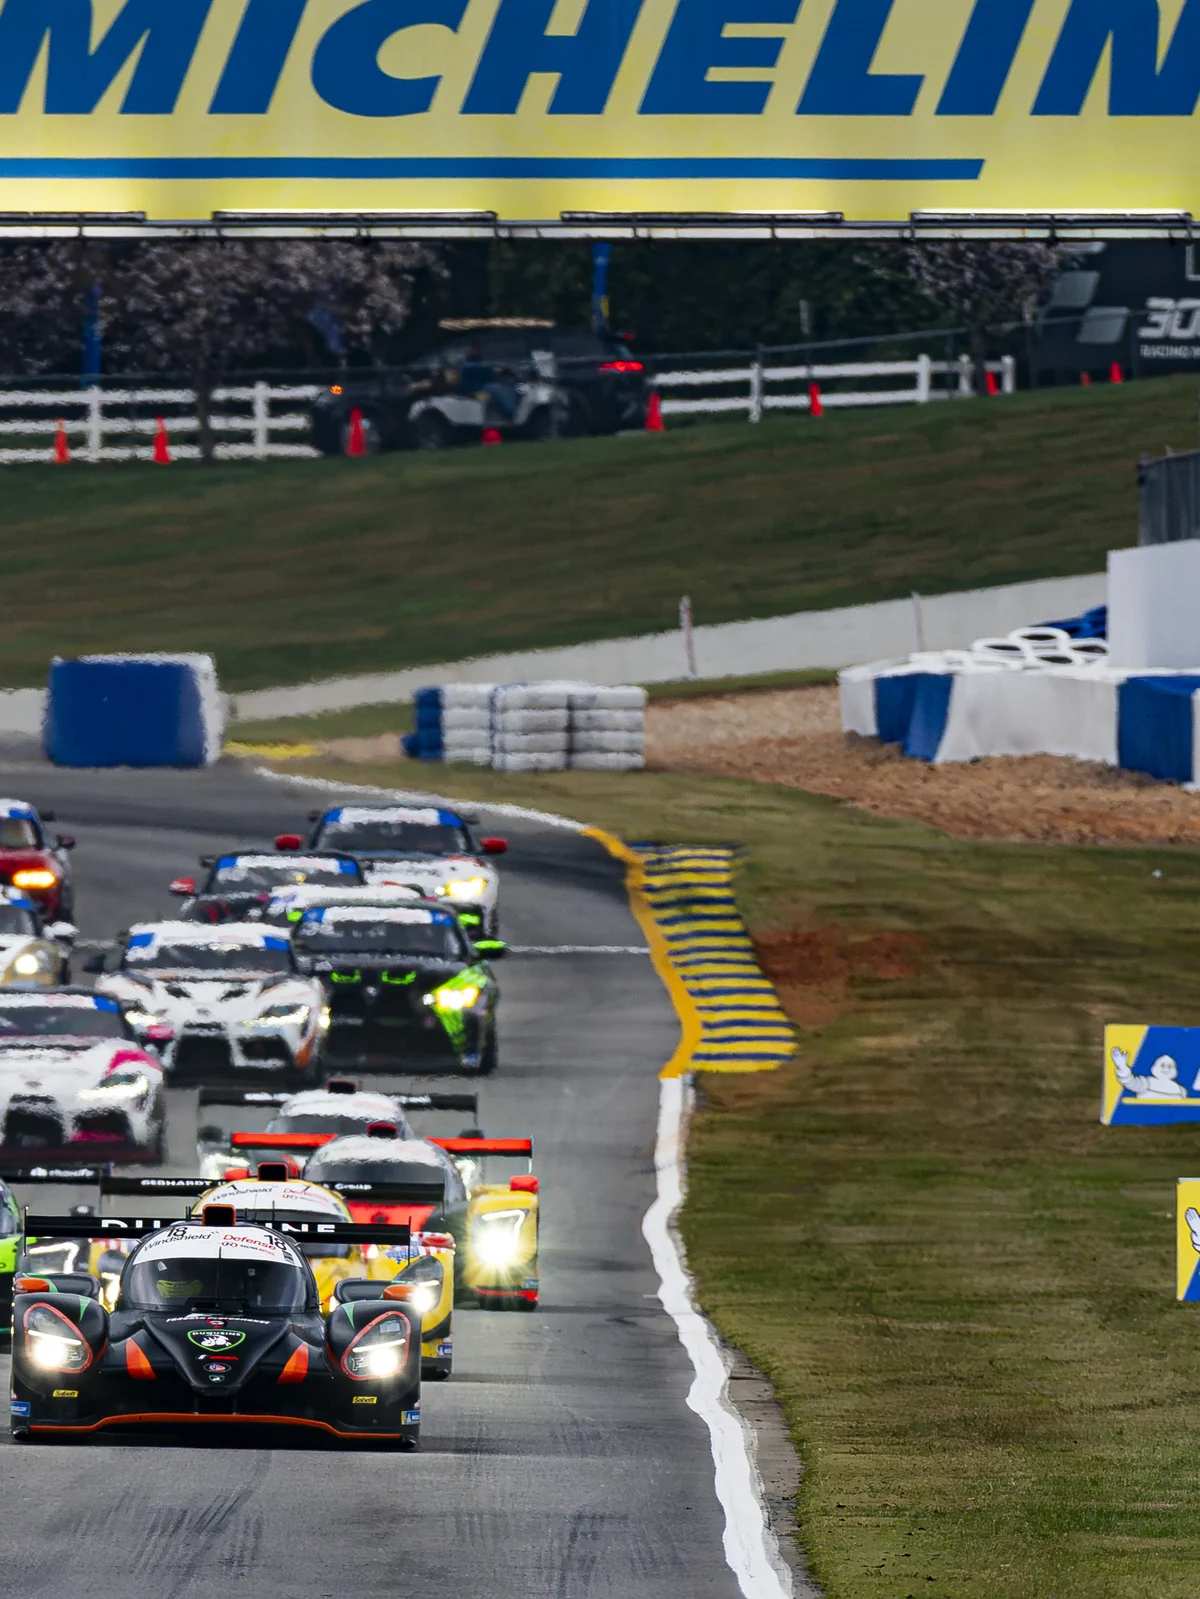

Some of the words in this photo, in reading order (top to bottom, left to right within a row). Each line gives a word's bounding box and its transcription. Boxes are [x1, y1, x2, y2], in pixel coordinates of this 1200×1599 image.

[166, 1226, 189, 1238] 18
[143, 1231, 212, 1251] Windshield
[222, 1234, 277, 1251] Defense
[263, 1234, 288, 1251] 18
